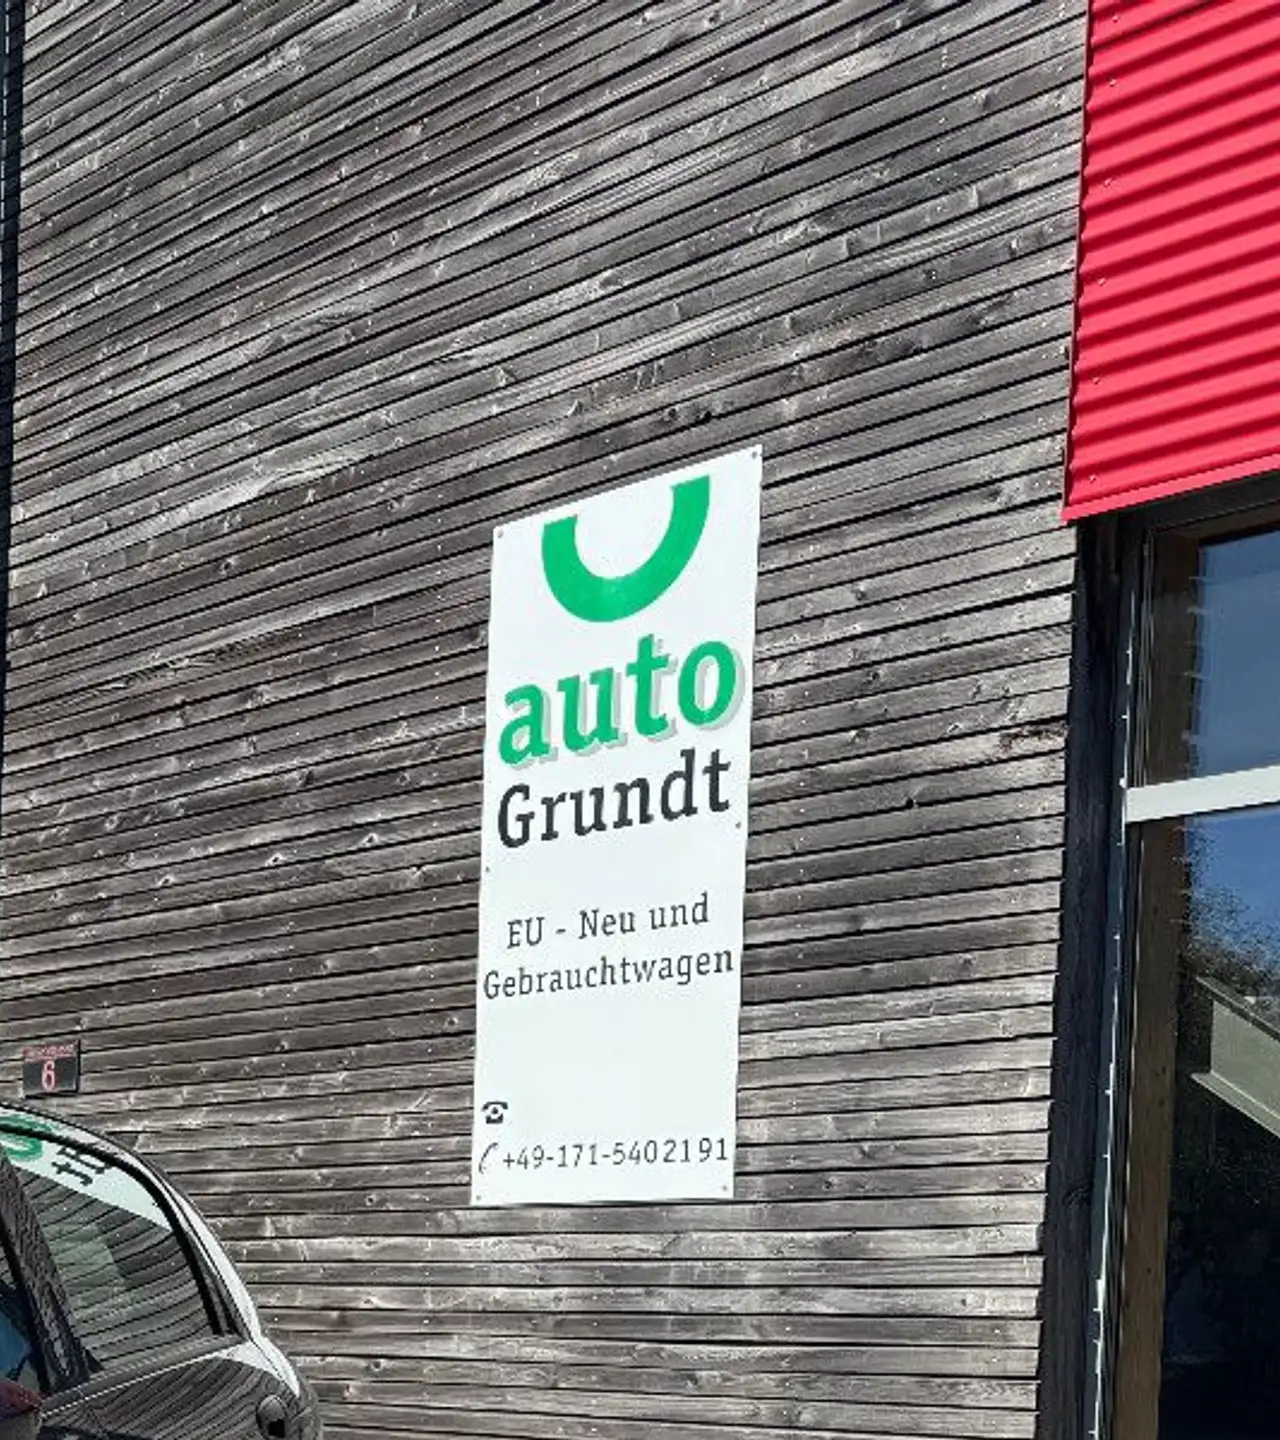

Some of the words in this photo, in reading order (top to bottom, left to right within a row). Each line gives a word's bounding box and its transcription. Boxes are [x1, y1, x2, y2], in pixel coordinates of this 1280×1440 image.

[497, 633, 740, 766] auto
[497, 747, 732, 848] Grundt
[506, 916, 545, 949] EU
[578, 908, 636, 940] Neu
[648, 890, 710, 931] und
[482, 949, 734, 1001] Gebrauchtwagen
[41, 1060, 56, 1092] 6
[502, 1137, 729, 1171] +49-171-5402191
